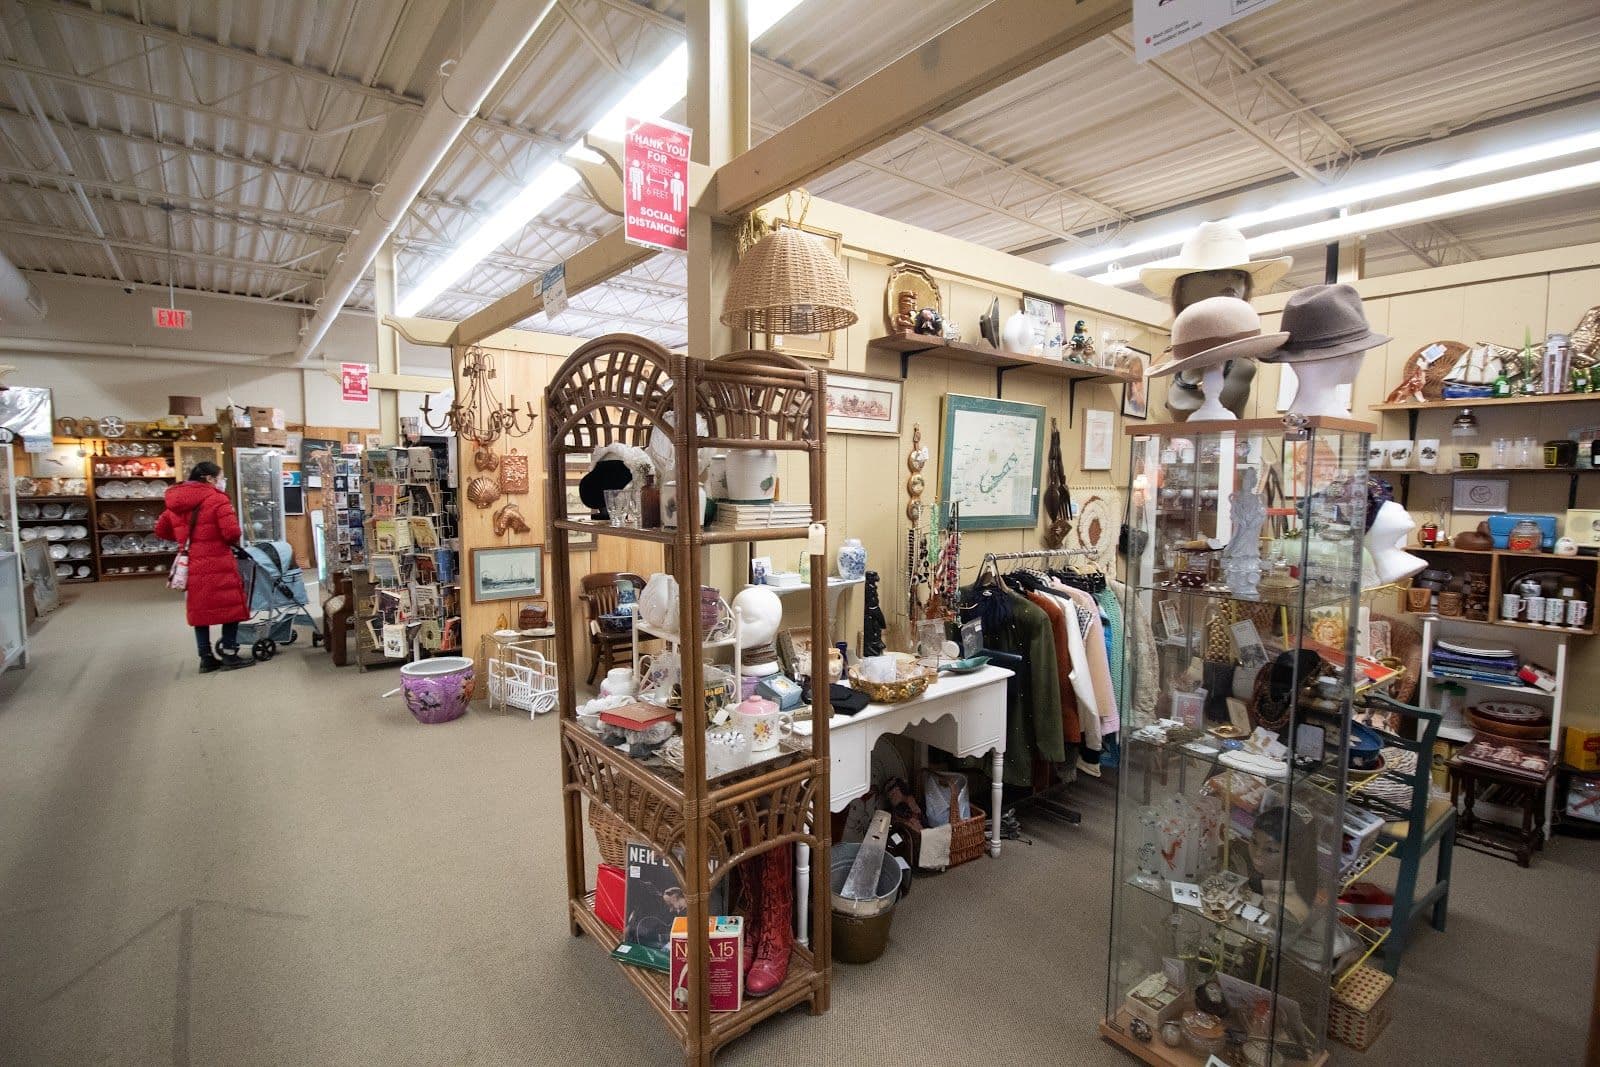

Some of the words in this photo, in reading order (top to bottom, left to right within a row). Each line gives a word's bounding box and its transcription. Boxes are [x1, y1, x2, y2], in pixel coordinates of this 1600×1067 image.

[630, 134, 664, 150] THANK
[666, 142, 686, 158] YOU
[647, 150, 668, 164] FOR
[640, 161, 646, 170] 2
[646, 188, 651, 196] 6
[653, 189, 669, 199] FEET
[640, 206, 675, 222] SOCIAL
[628, 215, 686, 237] DISTANCING
[157, 309, 185, 328] EXIT
[629, 846, 658, 866] NEIL
[717, 941, 734, 957] 15
